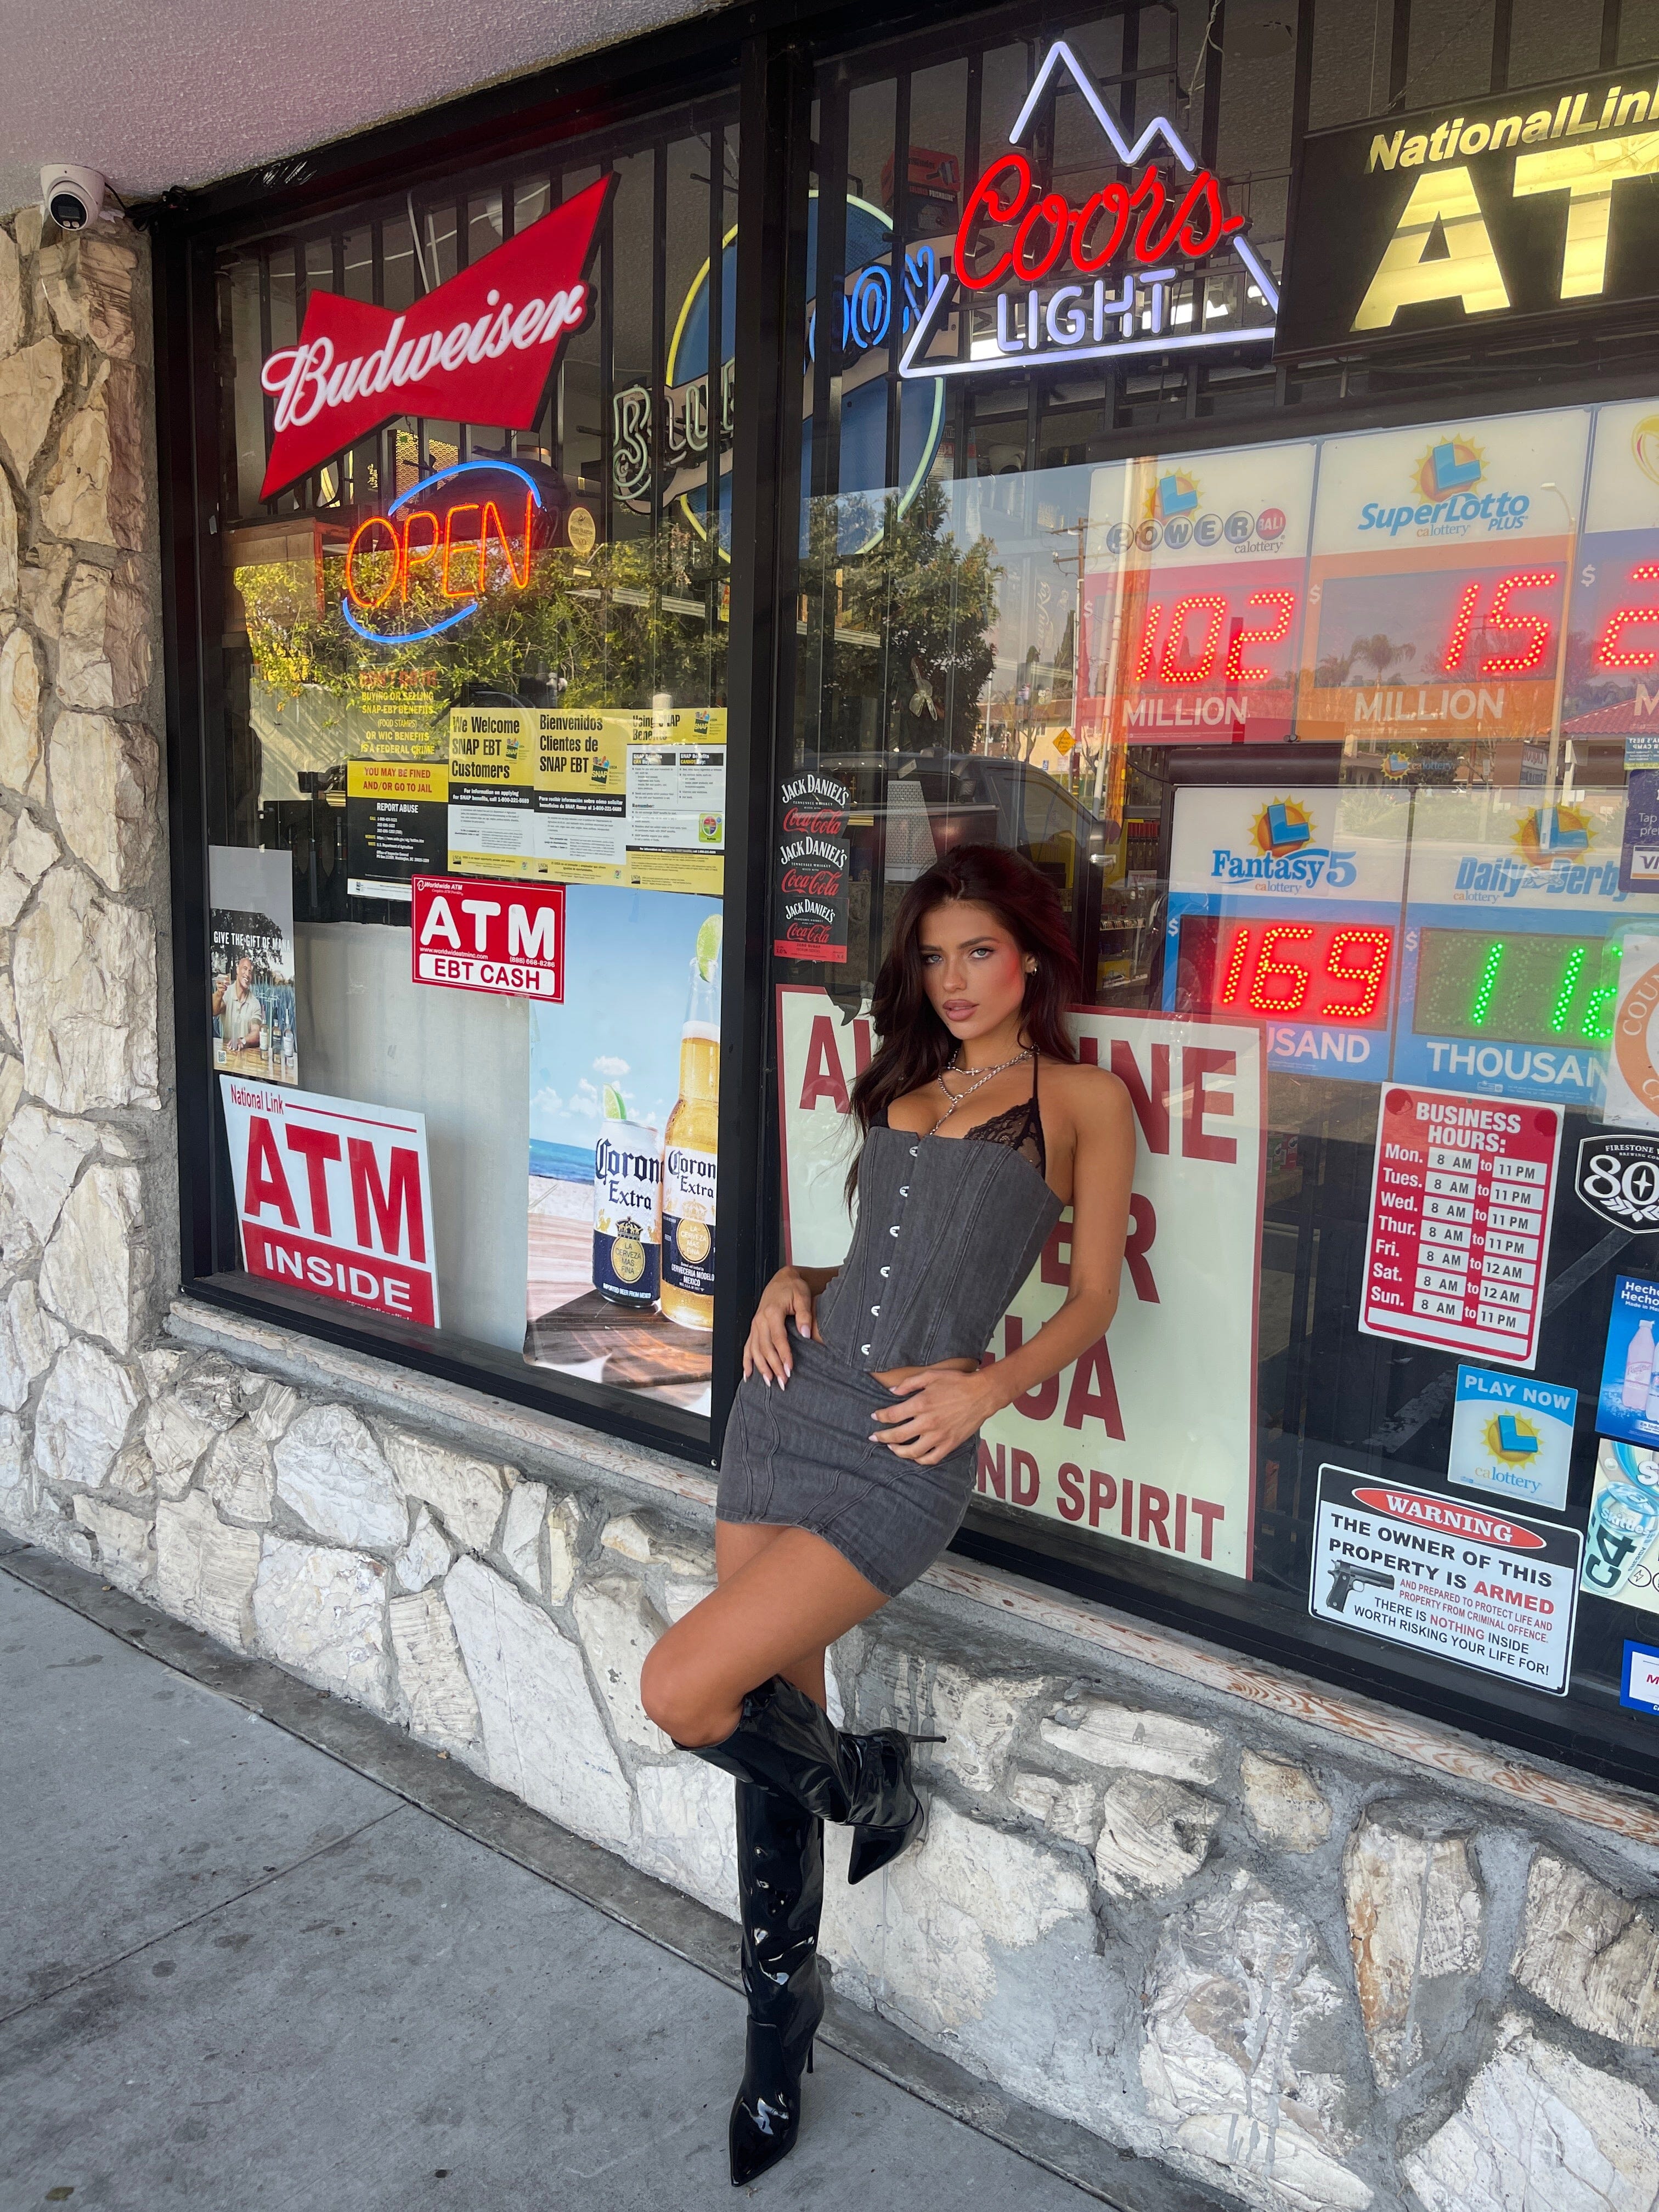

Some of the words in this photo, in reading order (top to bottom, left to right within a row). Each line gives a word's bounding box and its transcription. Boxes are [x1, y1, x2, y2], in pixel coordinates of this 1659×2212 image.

[1364, 83, 1659, 174] NationalLin
[953, 154, 1244, 290] Coors
[1349, 132, 1659, 332] AT
[997, 268, 1177, 352] LIGHT
[261, 285, 584, 433] Budweiser
[1357, 491, 1530, 536] SuperLotto
[1417, 524, 1471, 538] calottery
[1488, 516, 1526, 531] PLUS
[1108, 512, 1255, 554] POWER
[1257, 517, 1285, 532] BALL
[1234, 540, 1284, 554] calottery
[346, 490, 534, 608] OPEN
[1135, 591, 1295, 683] 102
[1445, 573, 1556, 671] 15
[1122, 696, 1249, 727] MILLION
[1354, 688, 1505, 721] MILLION
[366, 731, 376, 740] OR
[379, 732, 392, 740] WIC
[395, 732, 430, 741] BENEFITS
[453, 716, 467, 733] We
[471, 716, 520, 734] Welcome
[540, 714, 603, 731] Bienvenidos
[369, 744, 375, 753] A
[376, 744, 409, 754] FEDERAL
[411, 745, 435, 754] CRIME
[453, 738, 479, 755] SNAP
[483, 739, 501, 756] EBT
[540, 735, 581, 752] Clientes
[585, 737, 599, 752] de
[364, 767, 379, 776] YOU
[381, 768, 396, 777] MAY
[398, 769, 408, 777] BE
[409, 769, 431, 778] FINED
[452, 760, 510, 778] Customers
[540, 756, 567, 772] SNAP
[570, 757, 589, 773] EBT
[1410, 760, 1454, 771] calottery
[363, 781, 392, 792] AND/OR
[394, 782, 405, 791] GO
[407, 783, 415, 792] TO
[417, 783, 432, 793] JAIL
[781, 778, 806, 803] JACK
[808, 774, 849, 806] DANIEL'S
[376, 803, 399, 812] REPORT
[399, 804, 419, 813] ABUSE
[1639, 812, 1657, 826] Tap
[780, 840, 805, 865] JACK
[806, 837, 848, 868] DANIEL'S
[1211, 849, 1325, 889] Fantasy
[1327, 851, 1357, 888] 5
[1455, 857, 1527, 898] Daily
[425, 881, 450, 890] Worldwide
[1255, 882, 1302, 895] calottery
[1454, 891, 1499, 904] calottery
[213, 930, 229, 945] GIVE
[231, 932, 244, 946] THE
[246, 934, 261, 949] GIFT
[262, 936, 270, 950] OF
[272, 938, 291, 952] MANA
[420, 895, 555, 961] ATM
[435, 958, 474, 981] EBT
[480, 964, 540, 991] CASH
[510, 956, 525, 964] (888)
[1223, 927, 1391, 1017] 169
[1427, 1042, 1608, 1088] THOUSAN
[231, 1084, 264, 1110] National
[265, 1091, 284, 1115] Link
[1416, 1102, 1521, 1133] BUSINESS
[1428, 1125, 1506, 1153] HOURS:
[1605, 1144, 1654, 1153] FIRESTONE
[1385, 1143, 1423, 1163] Mon.
[1437, 1154, 1444, 1165] 8
[1453, 1156, 1472, 1170] AM
[1480, 1159, 1493, 1171] to
[1499, 1164, 1511, 1176] 11
[1516, 1166, 1536, 1180] PM
[244, 1115, 426, 1264] ATM
[609, 1180, 652, 1210] Extra
[1383, 1167, 1423, 1188] Tues.
[1434, 1179, 1441, 1190] 8
[1449, 1181, 1469, 1194] AM
[1477, 1184, 1489, 1196] to
[1495, 1188, 1507, 1201] 11
[1512, 1192, 1531, 1205] PM
[616, 1247, 641, 1260] CERVEZA
[621, 1258, 635, 1266] MAS
[1375, 1239, 1400, 1257] Fri.
[1426, 1251, 1434, 1261] 8
[1442, 1254, 1461, 1266] AM
[1470, 1257, 1482, 1269] to
[1486, 1262, 1500, 1274] 12
[1503, 1265, 1522, 1279] AM
[263, 1242, 413, 1313] INSIDE
[621, 1266, 635, 1275] FINA
[671, 1263, 696, 1279] CERVECERIA
[696, 1270, 715, 1282] MODELO
[684, 1276, 701, 1286] MEXICO
[1370, 1286, 1404, 1307] Sun.
[1421, 1300, 1429, 1310] 8
[1436, 1302, 1455, 1315] AM
[1465, 1306, 1476, 1319] to
[1481, 1311, 1493, 1323] 11
[1498, 1314, 1516, 1328] PM
[1621, 1290, 1659, 1306] Hecho
[1465, 1375, 1516, 1397] PLAY
[1523, 1388, 1571, 1410] NOW
[1475, 1466, 1542, 1493] calottery
[977, 1438, 1040, 1507] ND
[1057, 1462, 1224, 1561] SPIRIT
[1385, 1494, 1513, 1543] WARNING
[1330, 1513, 1371, 1536] THE
[1378, 1527, 1454, 1561] OWNER
[1463, 1551, 1491, 1569] OF
[1499, 1560, 1553, 1588] THIS
[1585, 1525, 1638, 1588] C4
[1329, 1538, 1439, 1581] PROPERTY
[1447, 1572, 1466, 1589] IS
[1473, 1581, 1554, 1615] ARMED
[1399, 1590, 1441, 1610] PROPERTY
[1442, 1604, 1465, 1618] FROM
[1467, 1610, 1505, 1630] CRIMINAL
[1507, 1623, 1549, 1643] OFFENCE.
[1400, 1579, 1417, 1591] AND
[1419, 1583, 1460, 1604] PREPARED
[1463, 1596, 1472, 1607] TO
[1475, 1601, 1512, 1620] PROTECT
[1515, 1611, 1531, 1624] LIFE
[1534, 1617, 1553, 1631] AND
[1354, 1605, 1396, 1628] WORTH
[1400, 1620, 1448, 1643] RISKING
[1451, 1635, 1485, 1656] YOUR
[1489, 1647, 1515, 1665] LIFE
[1519, 1657, 1549, 1676] FOR!
[1374, 1597, 1412, 1617] THERE
[1416, 1610, 1426, 1622] IS
[1430, 1614, 1485, 1640] NOTHING
[1488, 1632, 1529, 1654] INSIDE
